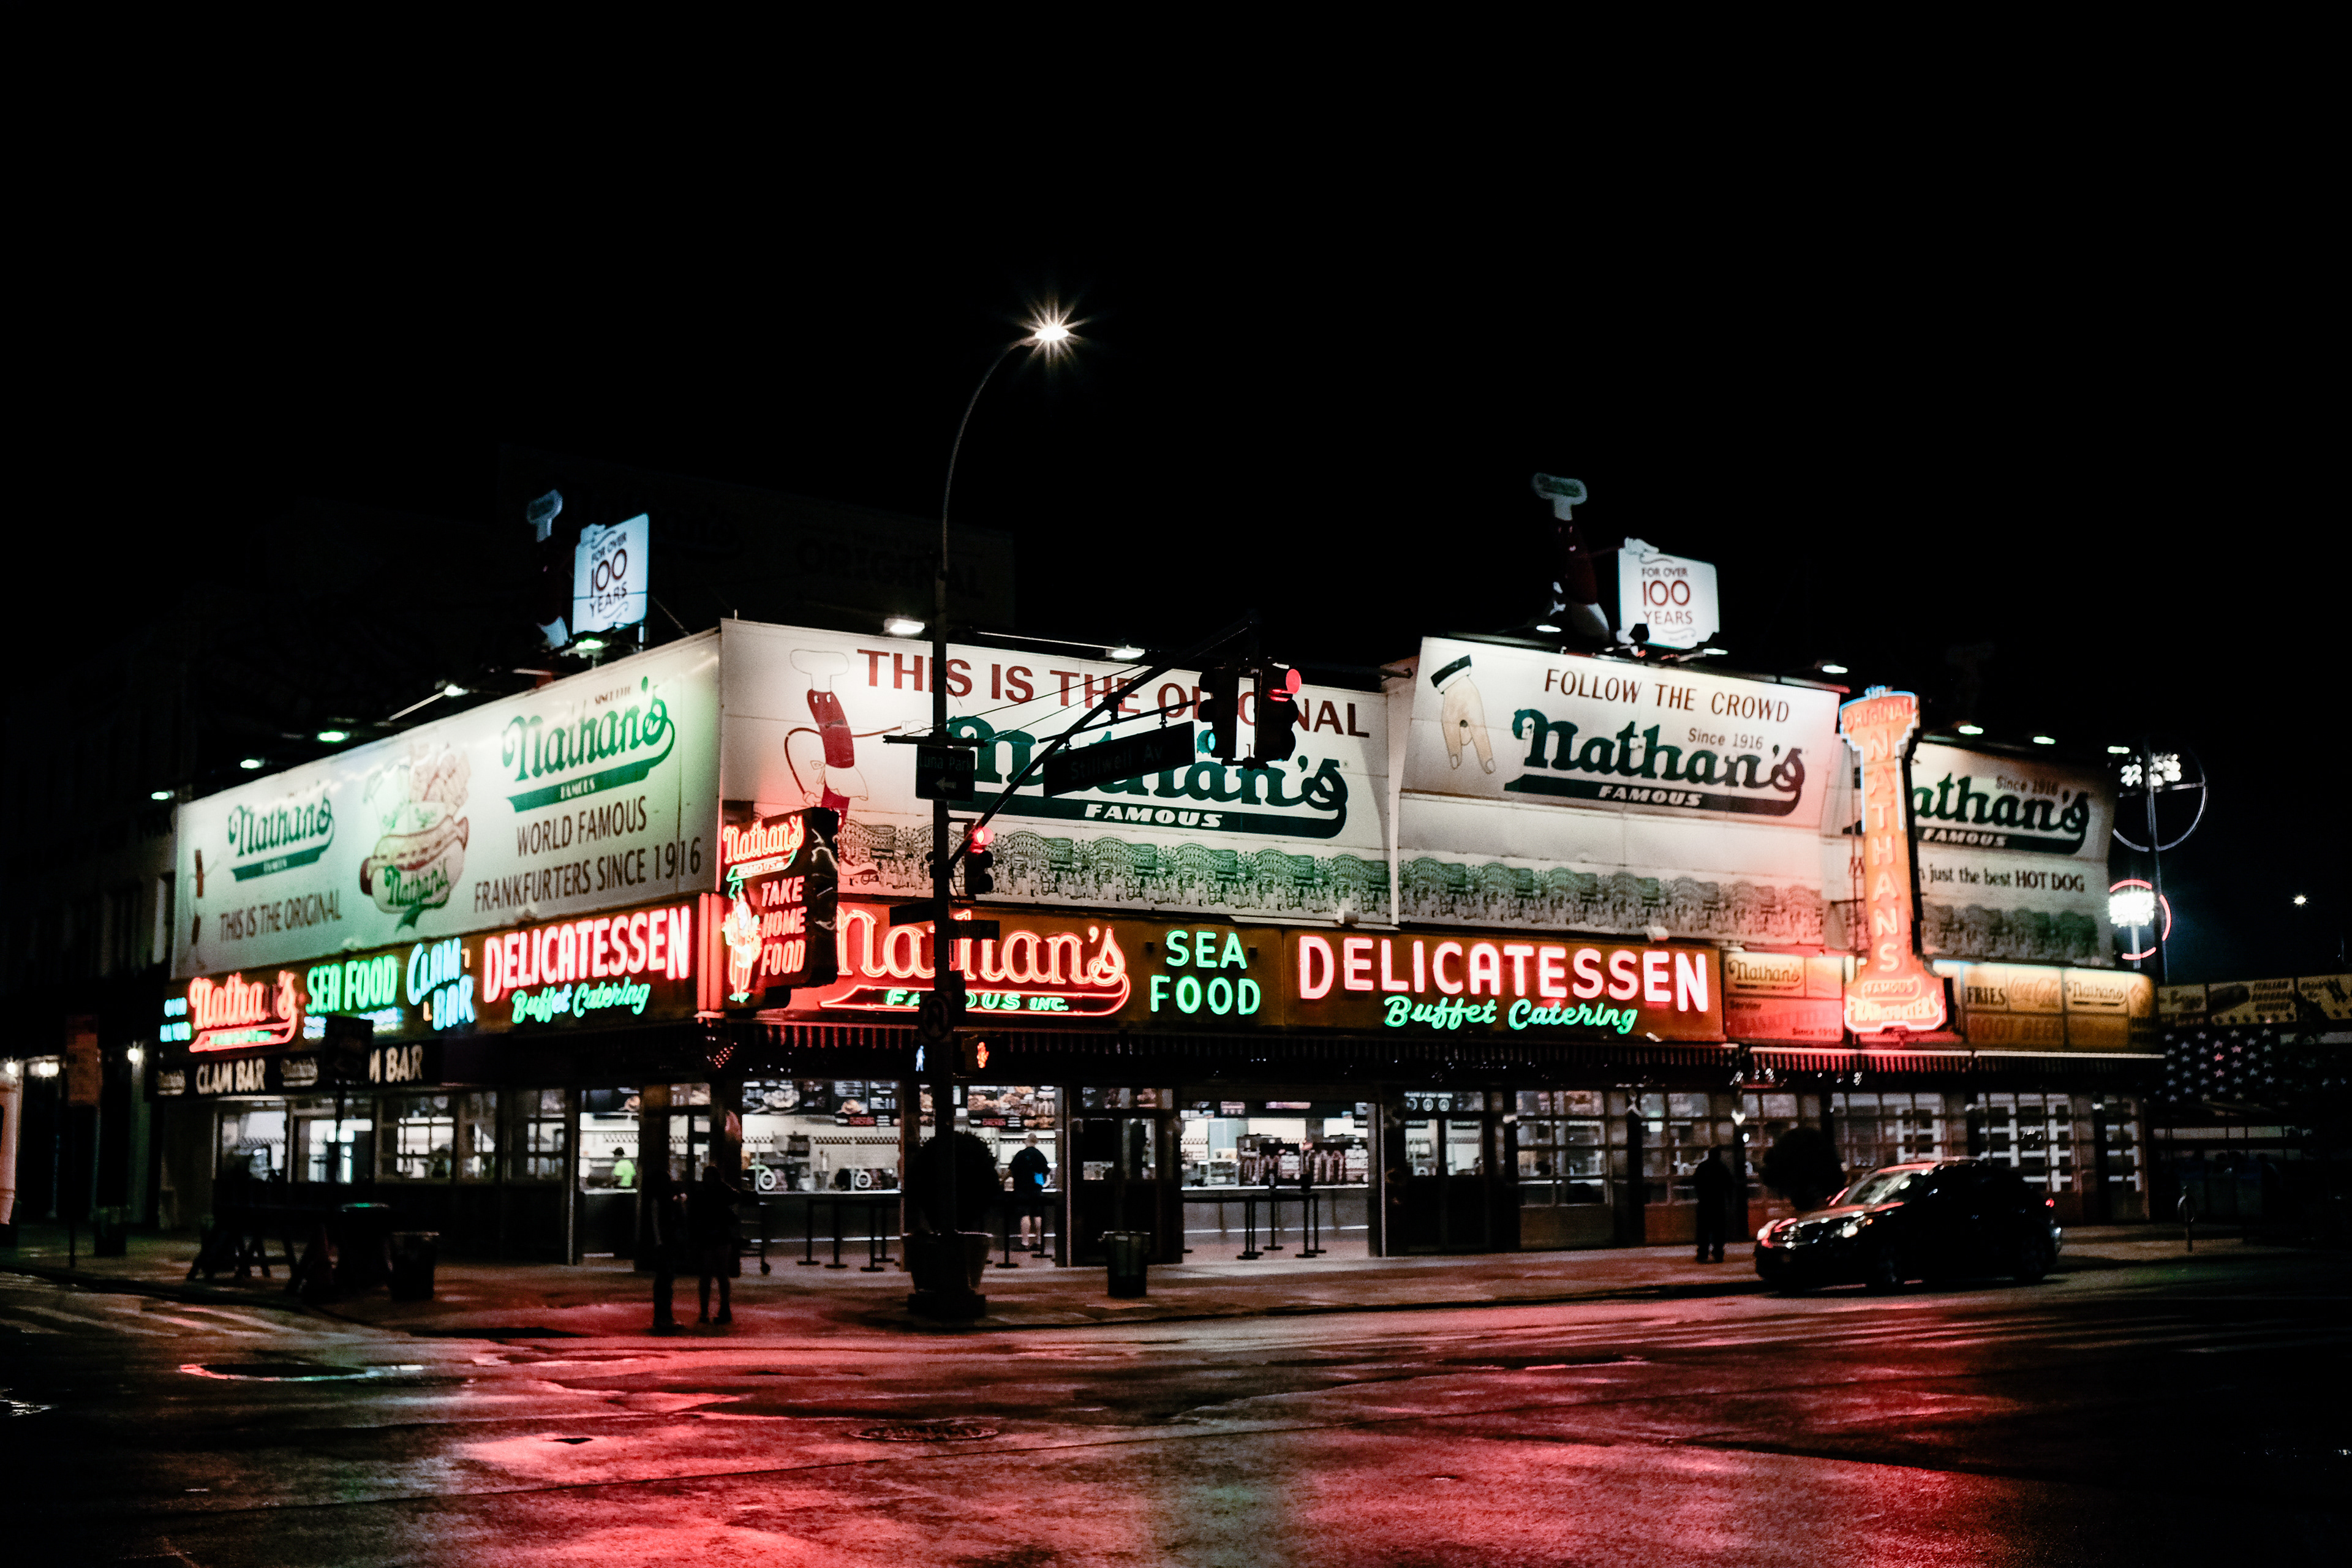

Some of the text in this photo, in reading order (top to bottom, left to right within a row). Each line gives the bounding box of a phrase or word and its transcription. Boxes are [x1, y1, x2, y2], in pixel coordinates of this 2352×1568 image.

[590, 549, 627, 598] 100
[1642, 567, 1688, 577] FOR OVER
[590, 581, 627, 617] YEARS
[1643, 580, 1691, 606] 100
[1643, 611, 1692, 625] YEARS
[991, 663, 1034, 704] IS
[1545, 669, 1790, 723] FOLLOW THE CROWD
[502, 676, 675, 782] Nathan's
[1843, 698, 1913, 732] ORIGINAL
[1512, 708, 1806, 793] Nathan's
[1688, 727, 1763, 750] Since 1916
[918, 752, 972, 772] Luna Park
[1070, 742, 1163, 781] Stillwell Av
[1085, 804, 1223, 828] FAMOUS
[1598, 785, 1703, 808] FAMOUS
[1913, 771, 2089, 835] athan's
[228, 793, 334, 858] Nathan's
[516, 796, 646, 857] WORLD FAMOUS
[723, 815, 805, 864] Nathan's
[1923, 828, 2008, 847] FAMOUS
[1869, 729, 1901, 973] NATHANS
[474, 837, 701, 913] FRANKFURTERS SINCE 1916
[761, 876, 805, 907] TAKE
[1930, 864, 1954, 883] just
[1959, 867, 1980, 884] the
[1984, 868, 2011, 888] best
[2016, 869, 2049, 890] HOT
[2051, 873, 2084, 893] DOG
[221, 889, 342, 943] THIS IS THE ORIGINAL
[762, 907, 807, 938] HOME
[483, 905, 690, 1003] DELICATESSEN
[761, 939, 805, 976] FOOD
[1166, 930, 1247, 969] SEA
[306, 955, 398, 1014] SEA FOOD
[407, 937, 461, 1006] CLAM
[1299, 935, 1708, 1012] DELICATESSEN
[1728, 959, 1800, 982] Nathan's
[432, 975, 475, 1031] BAR
[511, 976, 651, 1024] Buffet Catering
[1029, 996, 1069, 1011] INC.
[1150, 974, 1261, 1015] FOOD
[1967, 987, 2005, 1005] FRIES
[1384, 995, 1638, 1035] Buffet Catering
[196, 1063, 233, 1095] CLAM
[235, 1057, 266, 1092] BAR
[386, 1044, 423, 1083] BAR
